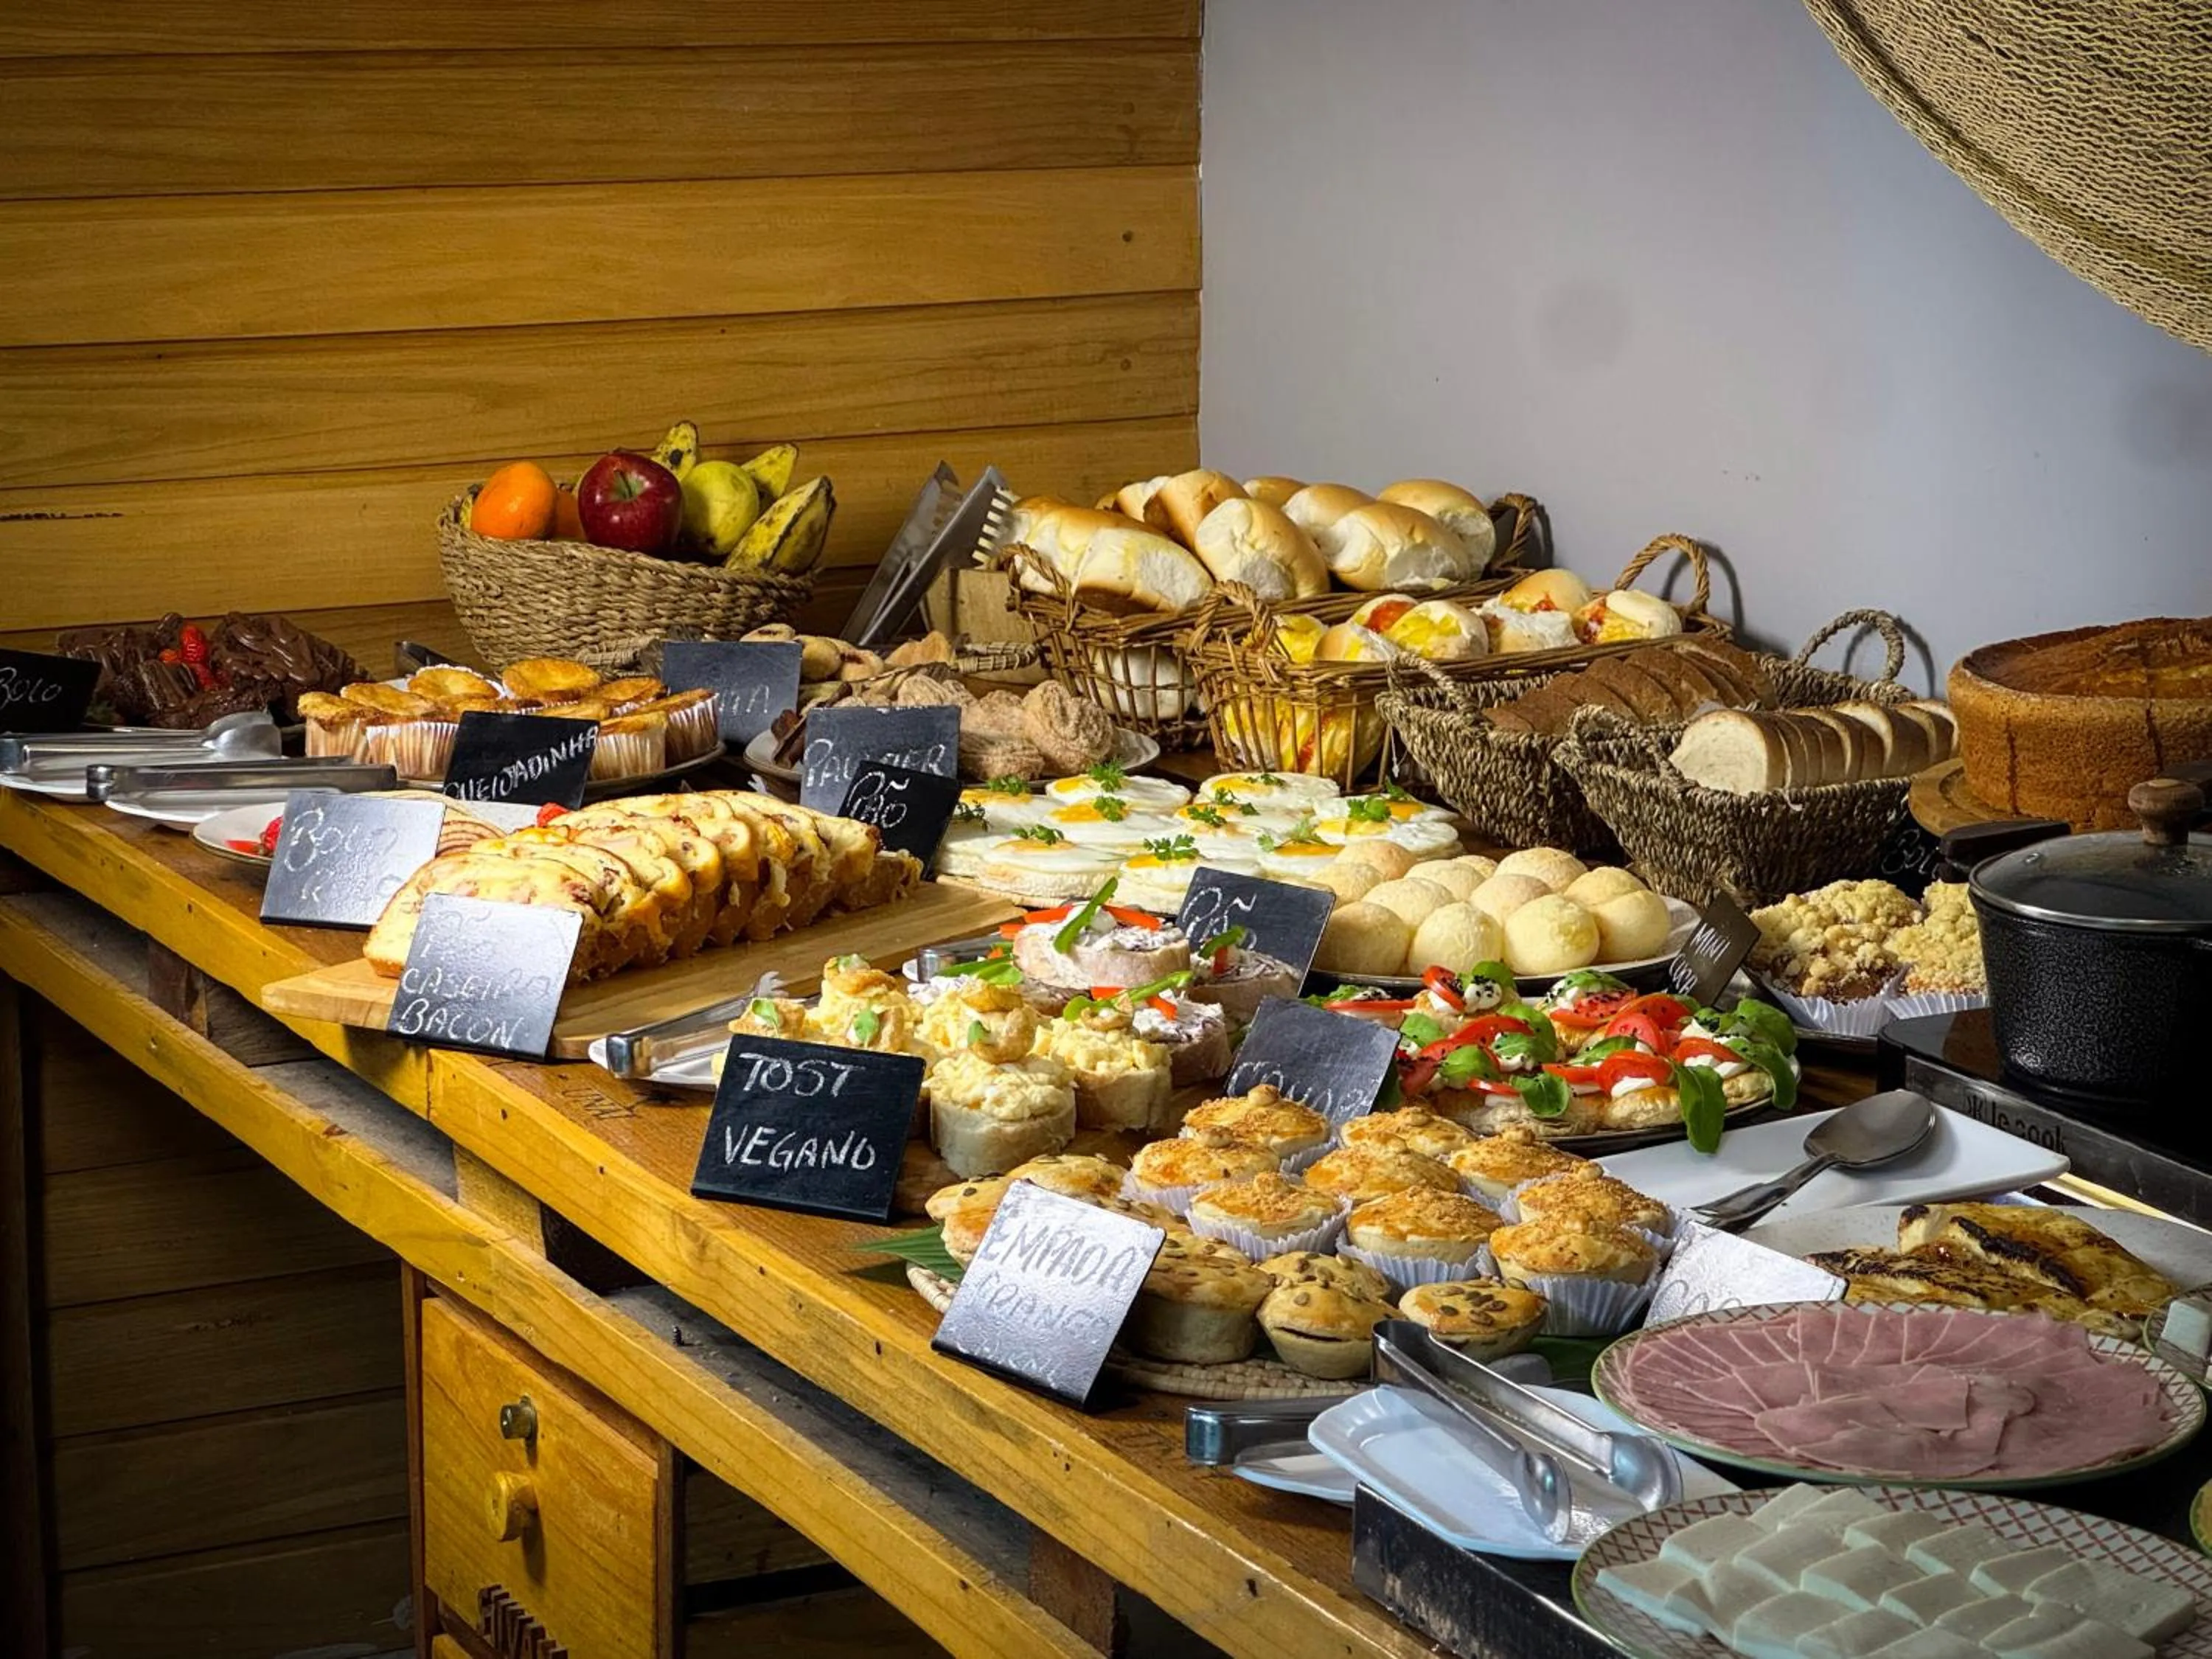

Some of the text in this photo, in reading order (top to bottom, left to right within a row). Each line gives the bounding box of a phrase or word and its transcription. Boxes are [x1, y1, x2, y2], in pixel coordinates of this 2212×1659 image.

[846, 771, 911, 829] PÃO
[1689, 922, 1731, 964] MINI
[399, 998, 524, 1050] BACON
[739, 1051, 866, 1097] TOST
[724, 1123, 876, 1174] VEGANO
